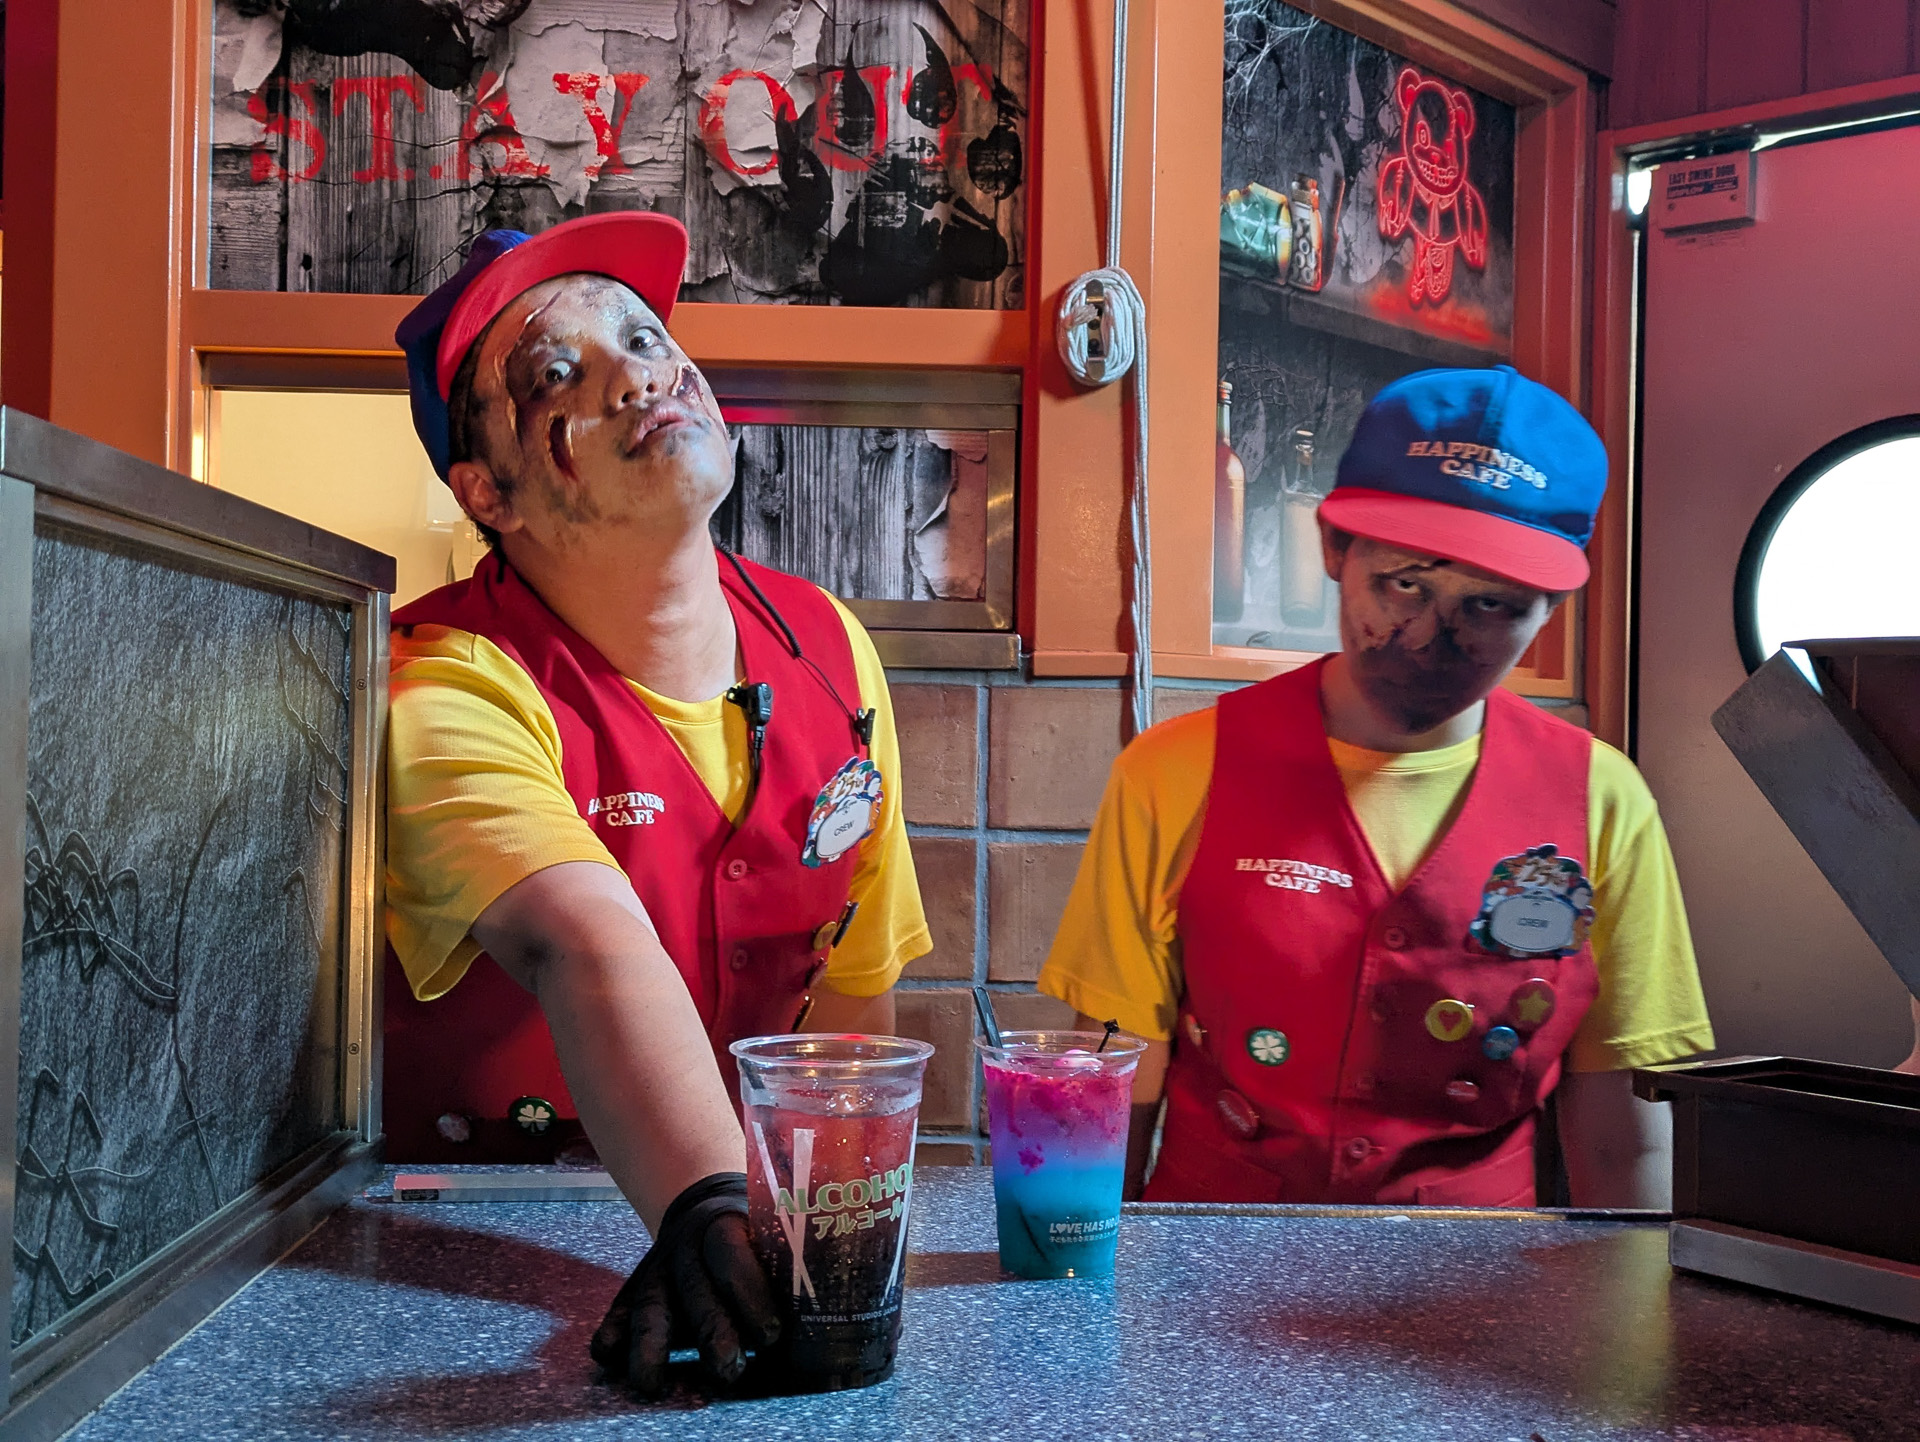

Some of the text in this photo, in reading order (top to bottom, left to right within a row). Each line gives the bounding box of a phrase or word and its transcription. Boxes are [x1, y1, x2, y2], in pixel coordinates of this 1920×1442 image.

[248, 64, 994, 183] STAY OUT
[1406, 441, 1548, 489] HAPPINESS
[1440, 459, 1513, 490] CAFE
[606, 809, 655, 826] CAFE
[1235, 858, 1353, 888] HAPPINESS
[1265, 873, 1321, 893] CAFE
[1082, 1221, 1105, 1234] HAS
[800, 1314, 849, 1323] UNIVERSAL
[851, 1309, 883, 1322] STUDIOS
